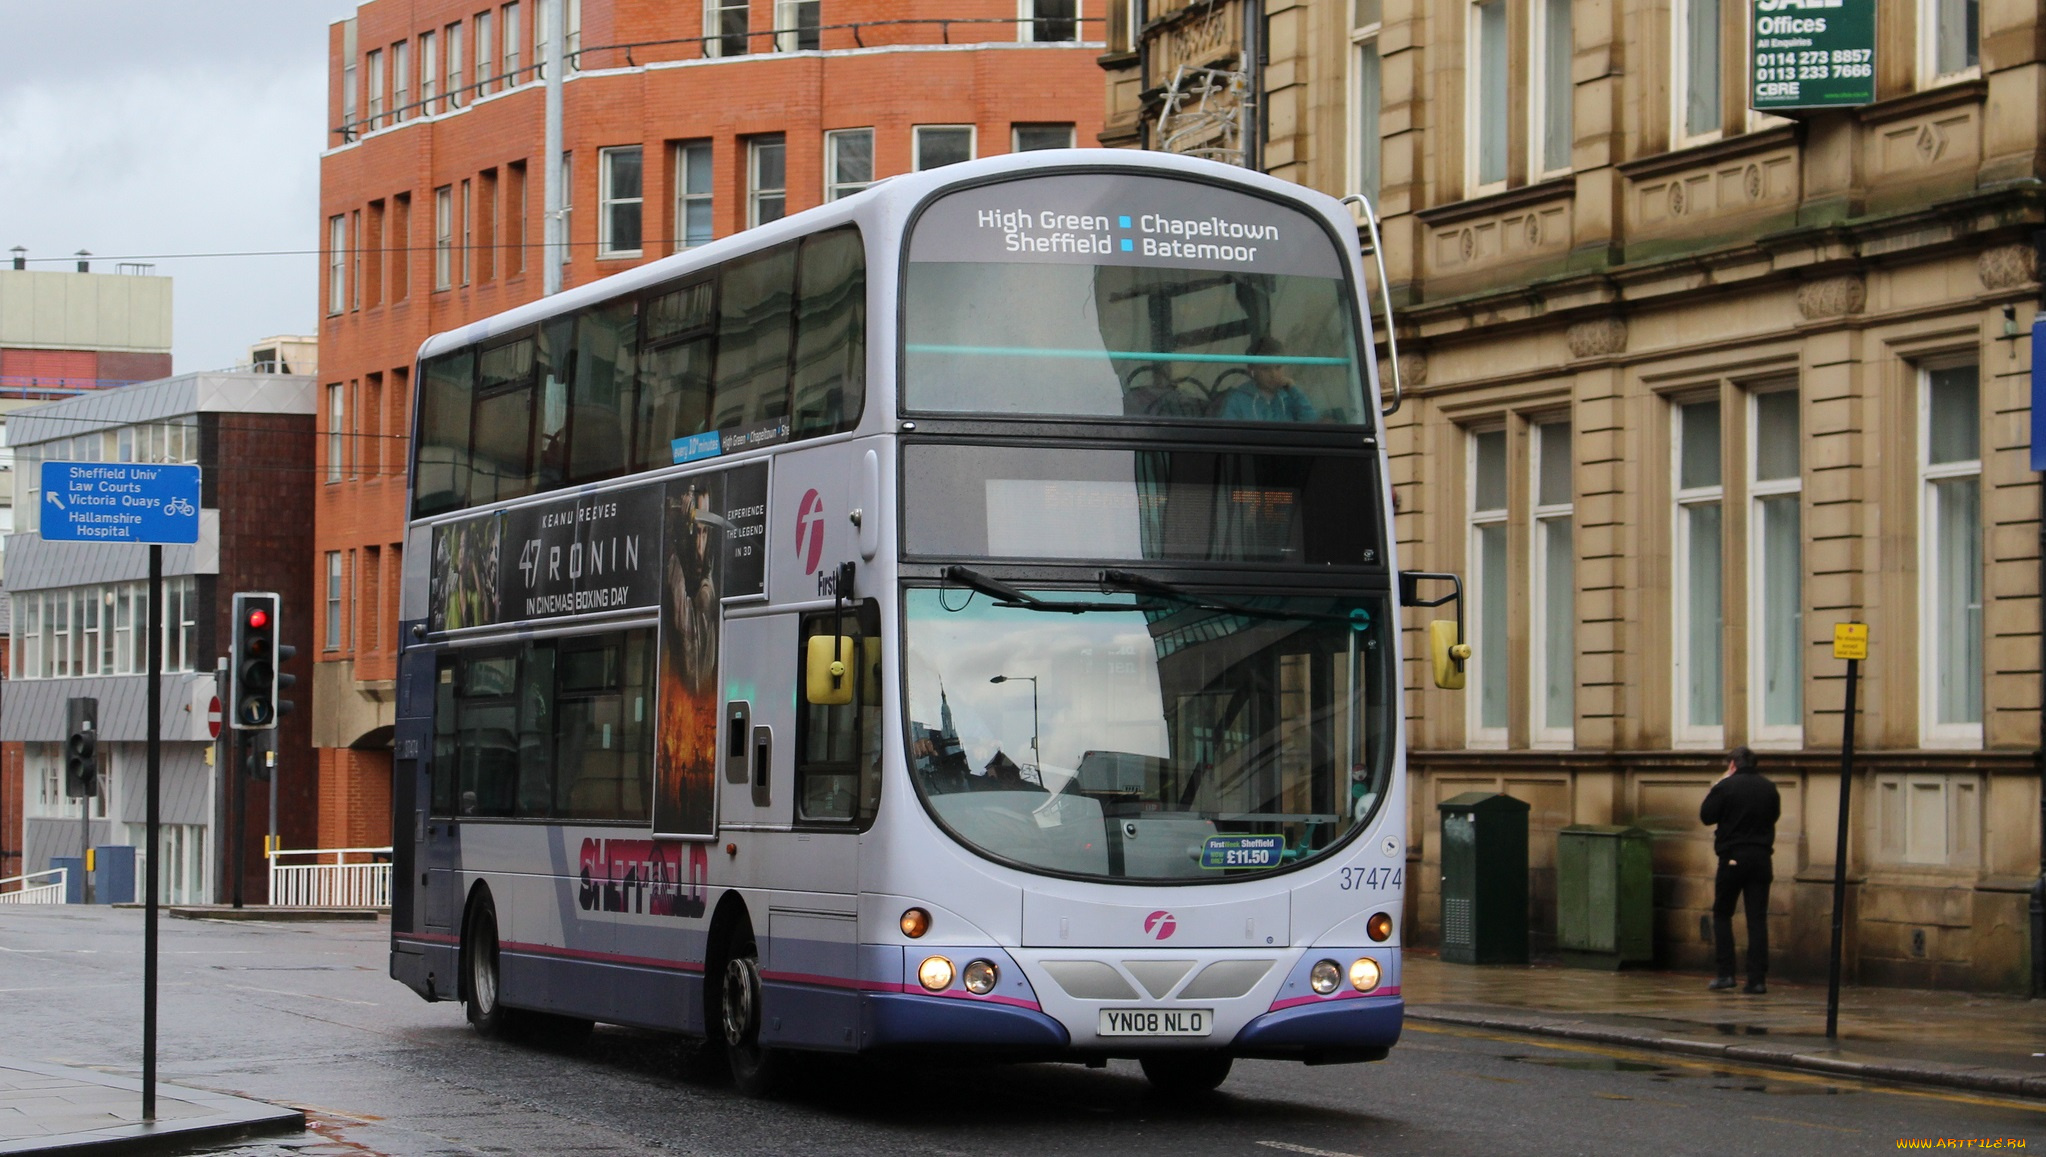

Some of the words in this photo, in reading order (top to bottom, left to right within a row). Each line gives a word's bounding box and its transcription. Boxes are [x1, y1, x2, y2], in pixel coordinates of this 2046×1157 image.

[1757, 16, 1827, 35] Offices
[1756, 39, 1769, 49] All
[1771, 38, 1813, 48] Enquiries
[1756, 52, 1796, 67] 0114
[1798, 51, 1829, 65] 273
[1831, 49, 1872, 64] 8857
[1756, 67, 1796, 81] 0113
[1798, 65, 1829, 80] 233
[1831, 63, 1872, 79] 7666
[1756, 81, 1800, 96] CBRE
[978, 209, 1032, 233] High
[1040, 211, 1109, 231] Green
[1141, 214, 1279, 240] Chapeltown
[1005, 233, 1112, 254] Sheffield
[1143, 238, 1257, 261] Batemoor
[722, 435, 732, 451] High
[733, 434, 746, 446] Green
[750, 427, 777, 444] Chapeltown
[674, 446, 688, 459] every
[699, 439, 719, 453] minutes
[69, 467, 125, 480] Sheffield
[69, 481, 93, 492] Law
[98, 481, 141, 493] Courts
[68, 494, 116, 506] Victoria
[121, 495, 160, 509] Quays
[69, 511, 142, 524] Hallamshire
[542, 510, 573, 529] KEANU
[578, 503, 617, 522] REEVES
[727, 504, 764, 521] EXPERIENCE
[77, 525, 129, 538] Hospital
[726, 528, 737, 540] THE
[738, 524, 763, 538] LEGEND
[735, 547, 742, 557] IN
[743, 546, 752, 556] 3D
[519, 539, 542, 588] 47
[548, 534, 639, 582] RONIN
[818, 570, 838, 597] First
[526, 597, 536, 615] IN
[536, 593, 573, 614] CINEMAS
[575, 588, 609, 610] BOXING
[610, 586, 629, 606] DAY
[1241, 839, 1274, 848] Sheffield
[1227, 850, 1270, 864] £11.50
[578, 838, 708, 919] SHEFFIELD
[1340, 867, 1402, 890] 37474
[1108, 1013, 1158, 1032] YN08
[1165, 1013, 1202, 1032] NLO
